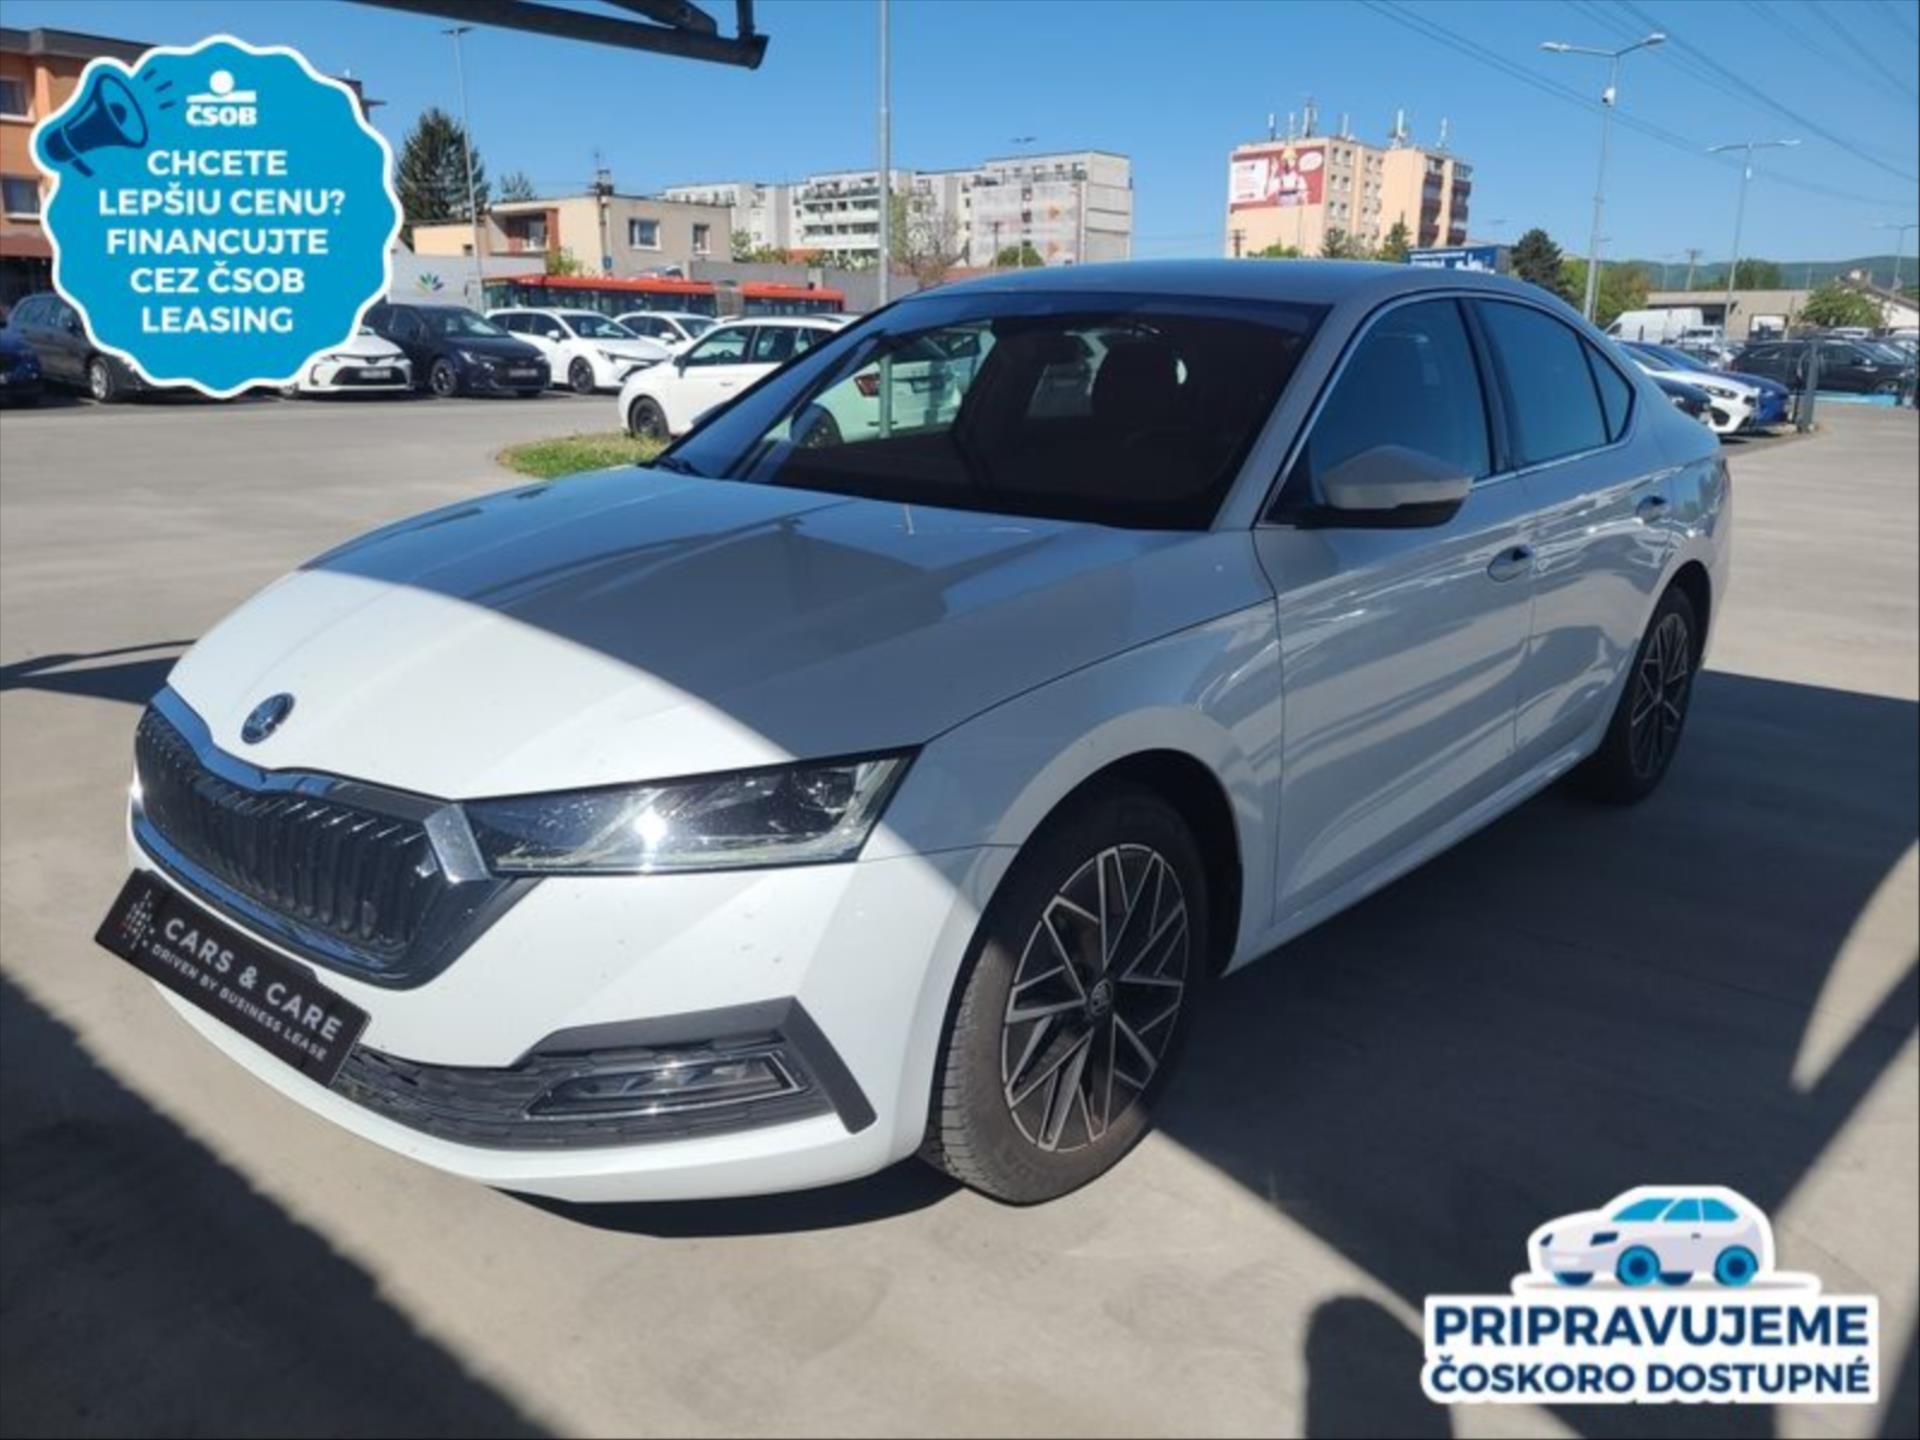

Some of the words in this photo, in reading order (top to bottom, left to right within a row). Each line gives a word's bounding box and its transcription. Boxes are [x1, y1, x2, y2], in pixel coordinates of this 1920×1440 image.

[152, 944, 198, 978] DRIVEN
[200, 973, 218, 991] BY
[219, 987, 281, 1032] BUSINESS
[283, 1027, 328, 1060] LEASE
[164, 919, 234, 973] CARS
[239, 966, 258, 989] &
[265, 982, 343, 1041] CARE
